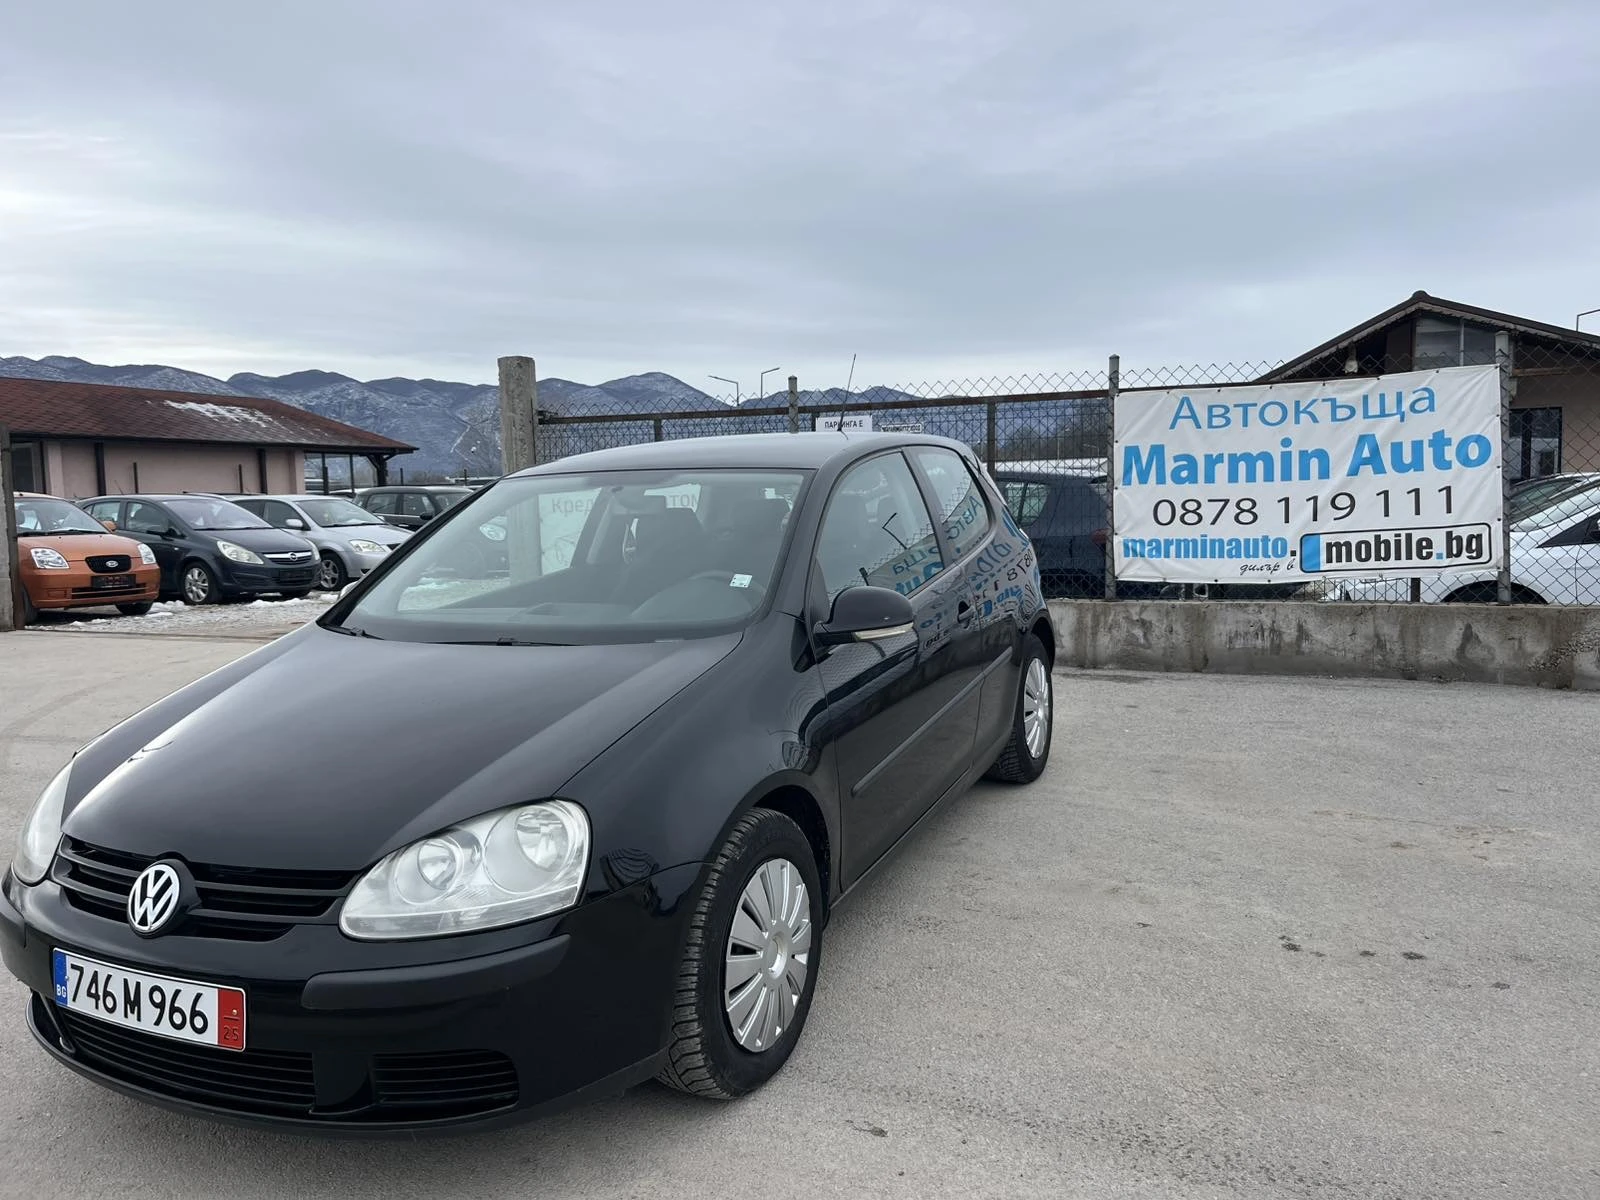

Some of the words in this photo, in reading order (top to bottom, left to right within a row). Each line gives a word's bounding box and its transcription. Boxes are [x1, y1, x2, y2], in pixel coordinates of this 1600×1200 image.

[824, 420, 857, 428] ПАРИНГА
[1168, 386, 1436, 432] Автокъща
[1121, 437, 1330, 486] Marmin
[1346, 430, 1492, 477] Auto
[1152, 497, 1259, 526] 0878
[1277, 491, 1356, 523] 119
[1375, 485, 1454, 518] 111
[1325, 530, 1483, 564] mobile.bg
[56, 984, 67, 998] BG
